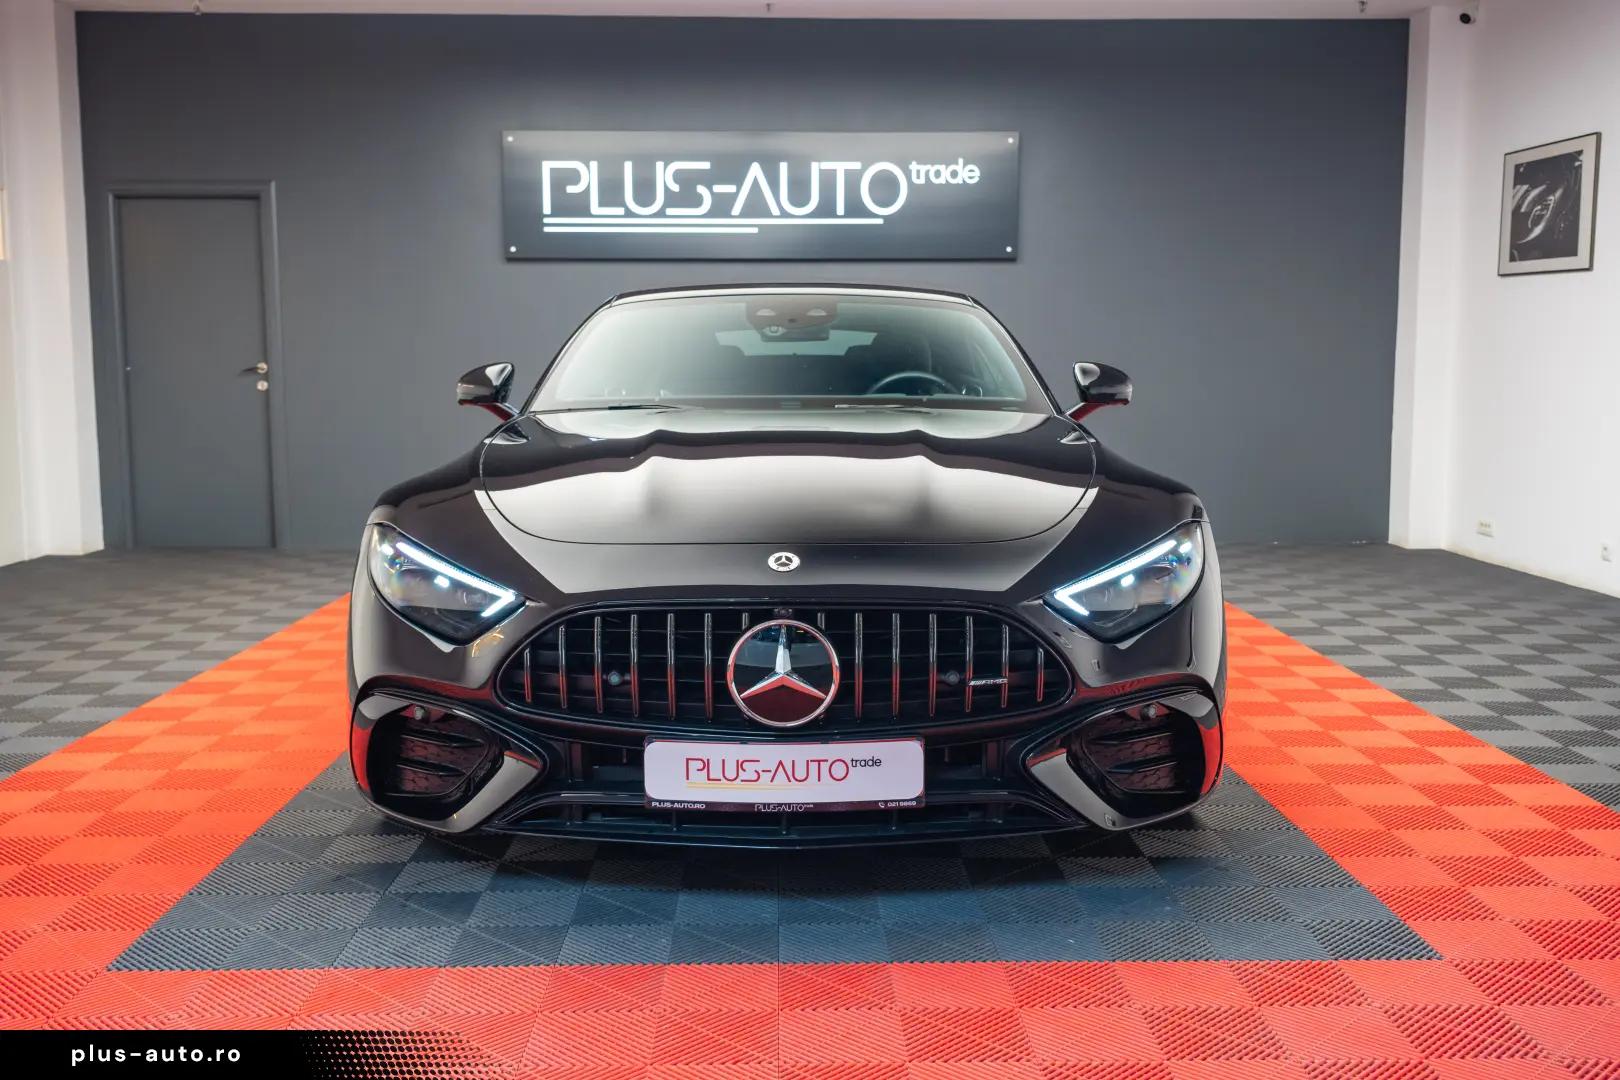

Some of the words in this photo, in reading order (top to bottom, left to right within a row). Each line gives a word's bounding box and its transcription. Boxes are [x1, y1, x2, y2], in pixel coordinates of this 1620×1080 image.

[541, 160, 908, 216] PLUS-AUTO
[909, 158, 981, 185] trade
[685, 757, 850, 783] PLUS-AUTO
[850, 756, 882, 768] trade
[754, 803, 805, 812] PLUS-AUTO
